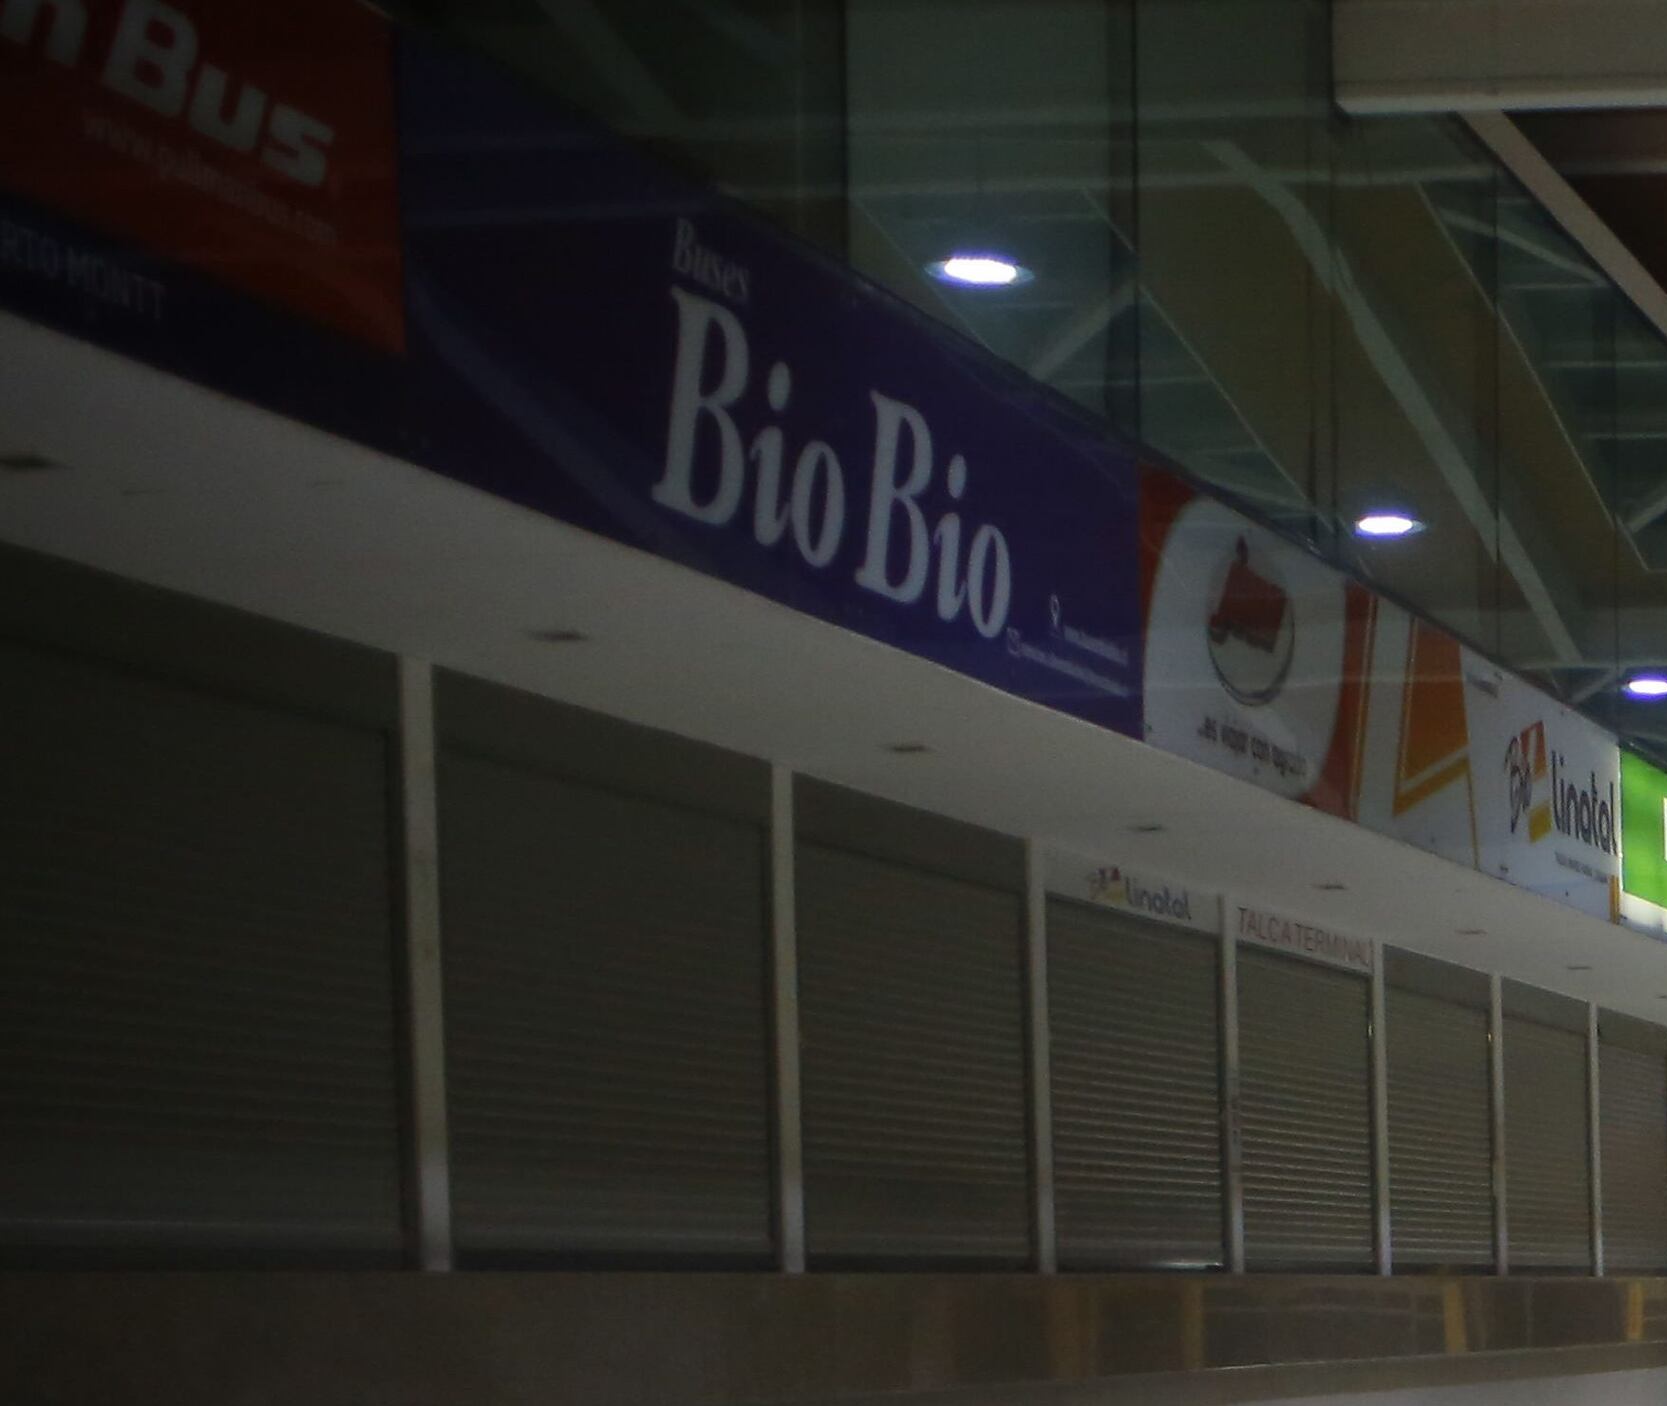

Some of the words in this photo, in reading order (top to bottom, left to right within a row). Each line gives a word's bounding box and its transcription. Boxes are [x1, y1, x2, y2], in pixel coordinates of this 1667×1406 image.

[103, 0, 335, 187] Bus
[672, 217, 751, 301] Buses
[652, 287, 845, 568] Bio
[854, 390, 1011, 637] Bio
